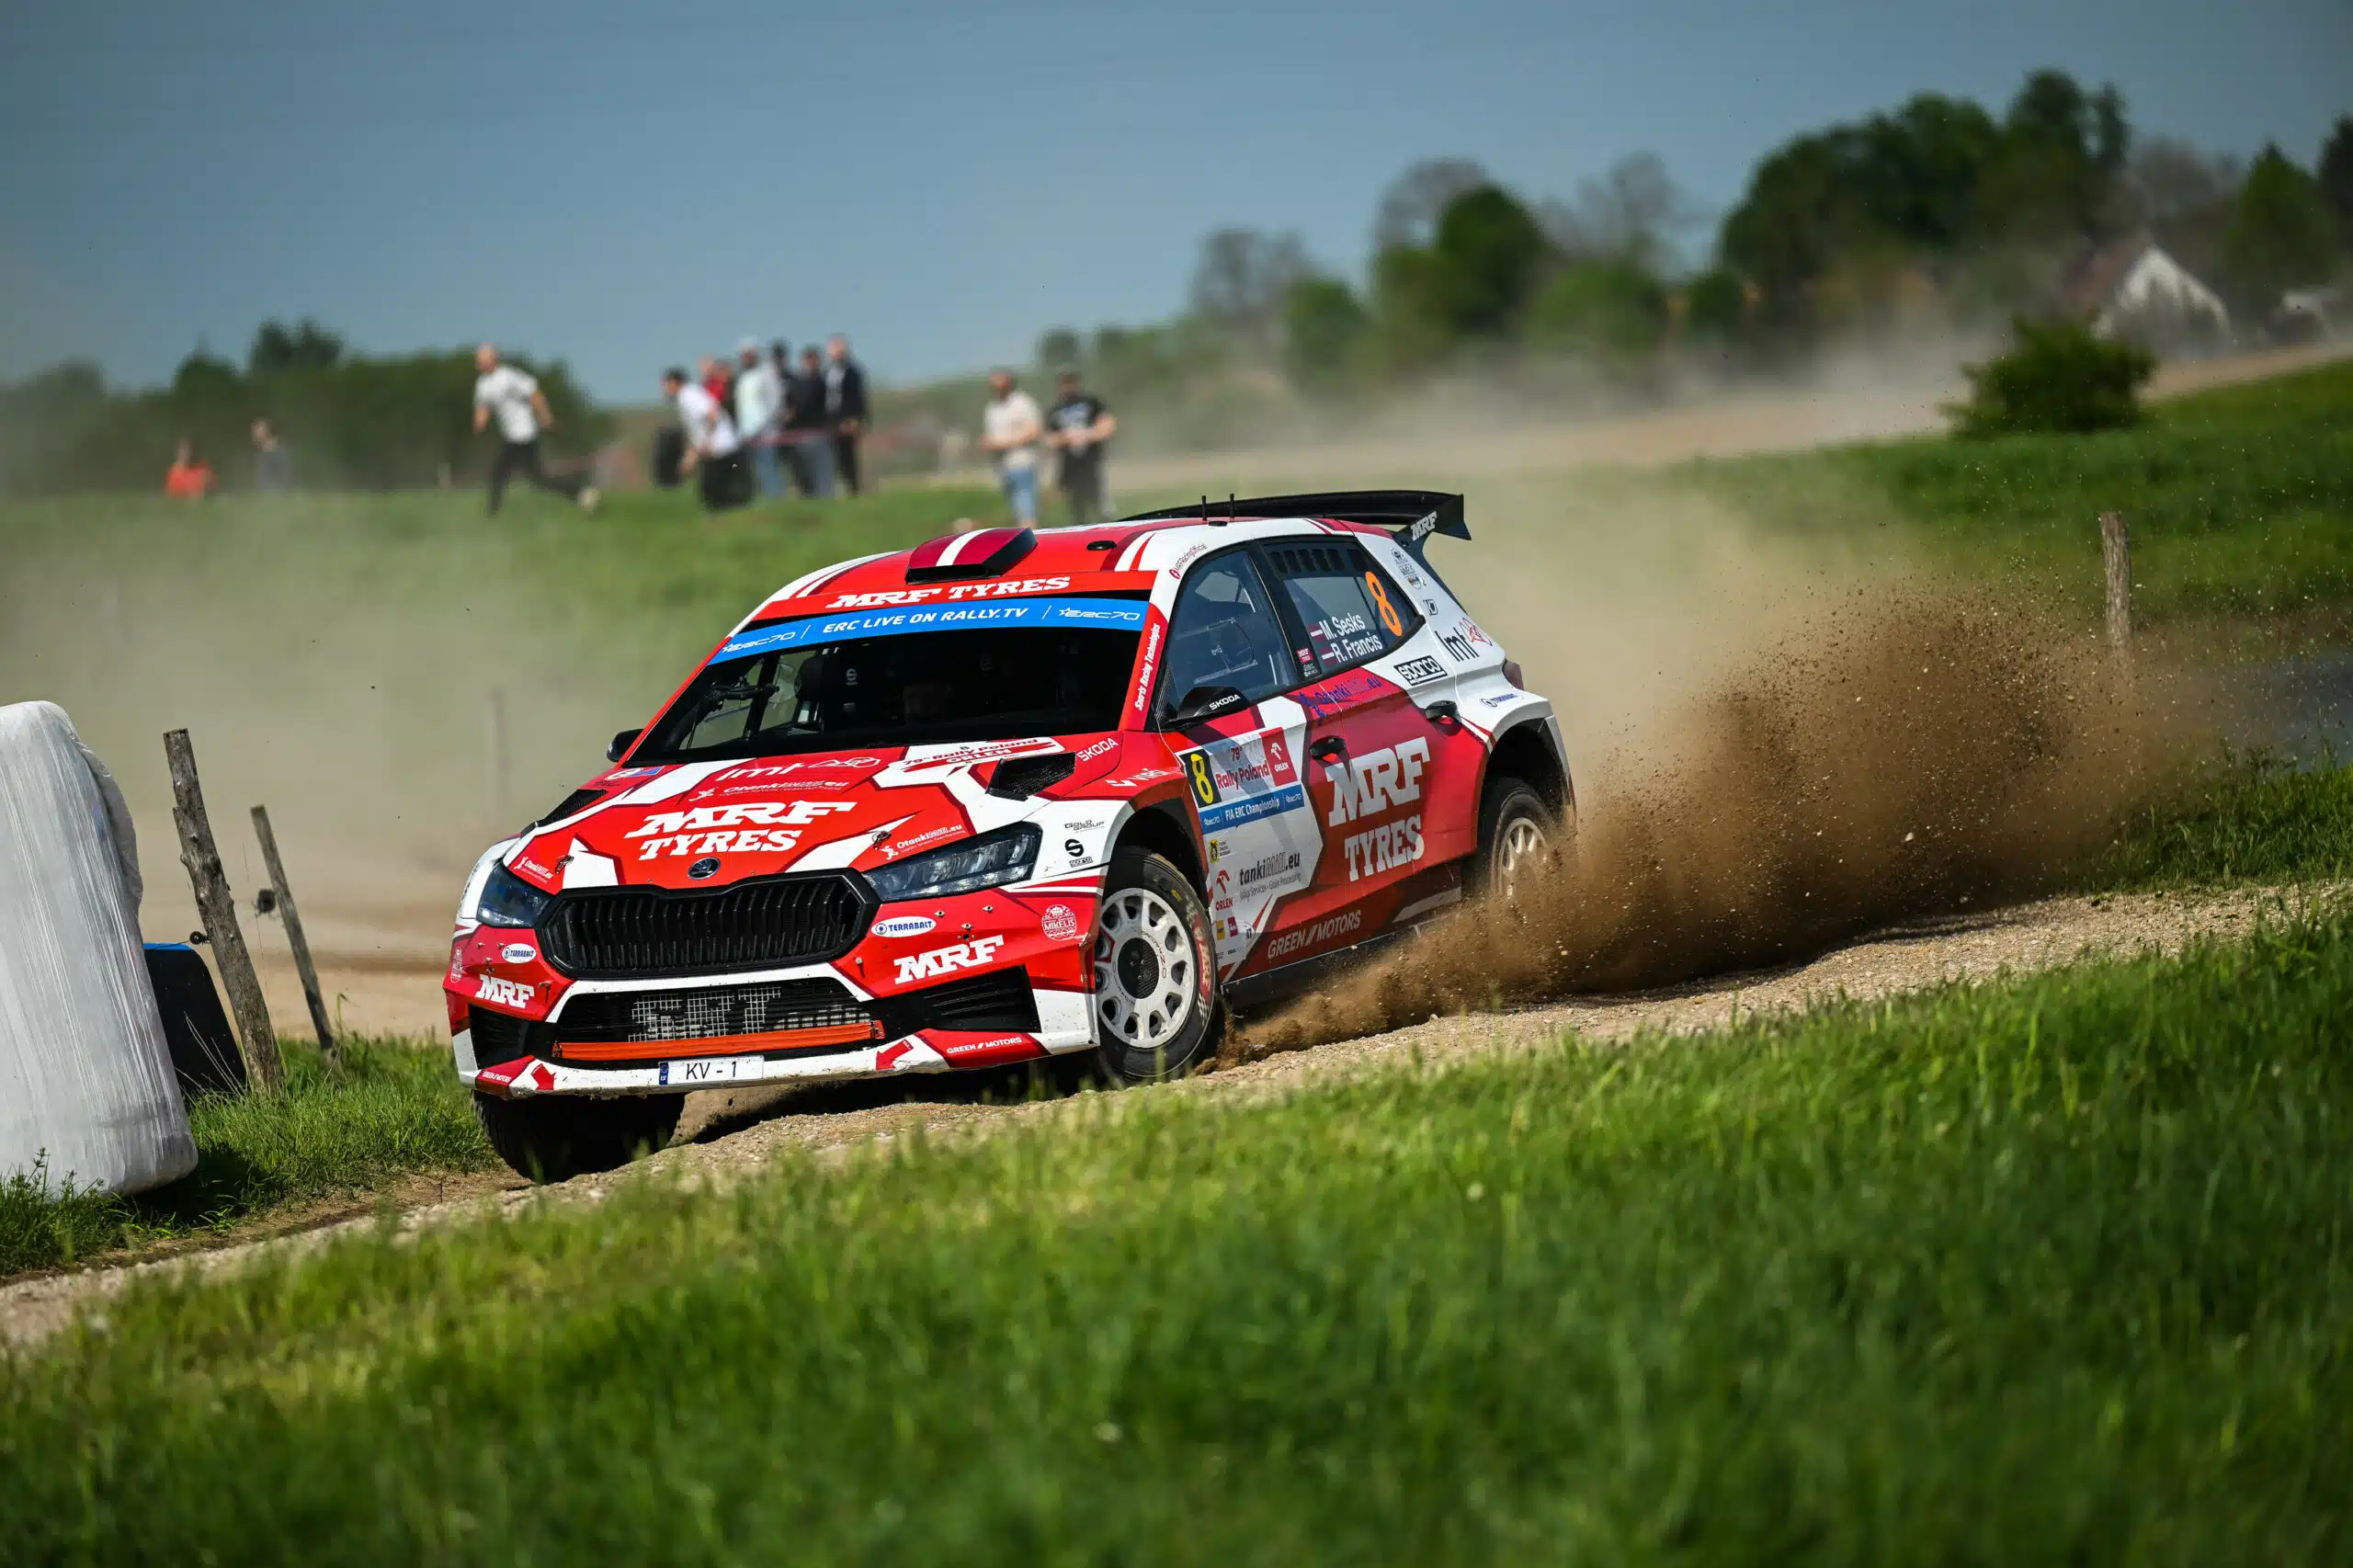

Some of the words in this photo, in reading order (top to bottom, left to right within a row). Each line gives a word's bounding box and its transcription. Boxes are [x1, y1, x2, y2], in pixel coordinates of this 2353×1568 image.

[1410, 511, 1437, 541] MRF
[824, 588, 943, 608] MRF
[948, 576, 1071, 599] TYRES
[1365, 571, 1403, 637] 8
[823, 619, 861, 634] ERC
[863, 615, 906, 629] LIVE
[909, 612, 938, 622] ON
[940, 608, 1029, 621] RALLY.TV
[1319, 619, 1337, 641] M.
[1332, 613, 1366, 637] Sesks
[1330, 642, 1347, 663] R.
[1342, 631, 1383, 659] Francis
[1399, 656, 1443, 684] sparco
[933, 749, 974, 760] Rally
[978, 739, 1039, 751] Poland
[1190, 754, 1213, 804] 8
[1215, 771, 1239, 790] Rally
[1238, 760, 1270, 783] Poland
[1324, 736, 1430, 827] MRF
[624, 800, 858, 838] MRF
[1224, 808, 1235, 821] FIA
[1234, 806, 1246, 818] ERC
[1245, 797, 1280, 816] Championship
[638, 829, 803, 860] TYRES
[1344, 813, 1424, 882] TYRES
[1216, 897, 1233, 911] ORLEN
[888, 921, 932, 932] TERRABALT
[1267, 928, 1307, 960] GREEN
[1316, 910, 1361, 942] MOTORS
[893, 935, 1005, 985] MRF
[474, 973, 535, 1009] MRF
[947, 1044, 976, 1054] GREEN
[985, 1037, 1022, 1048] MOTORS
